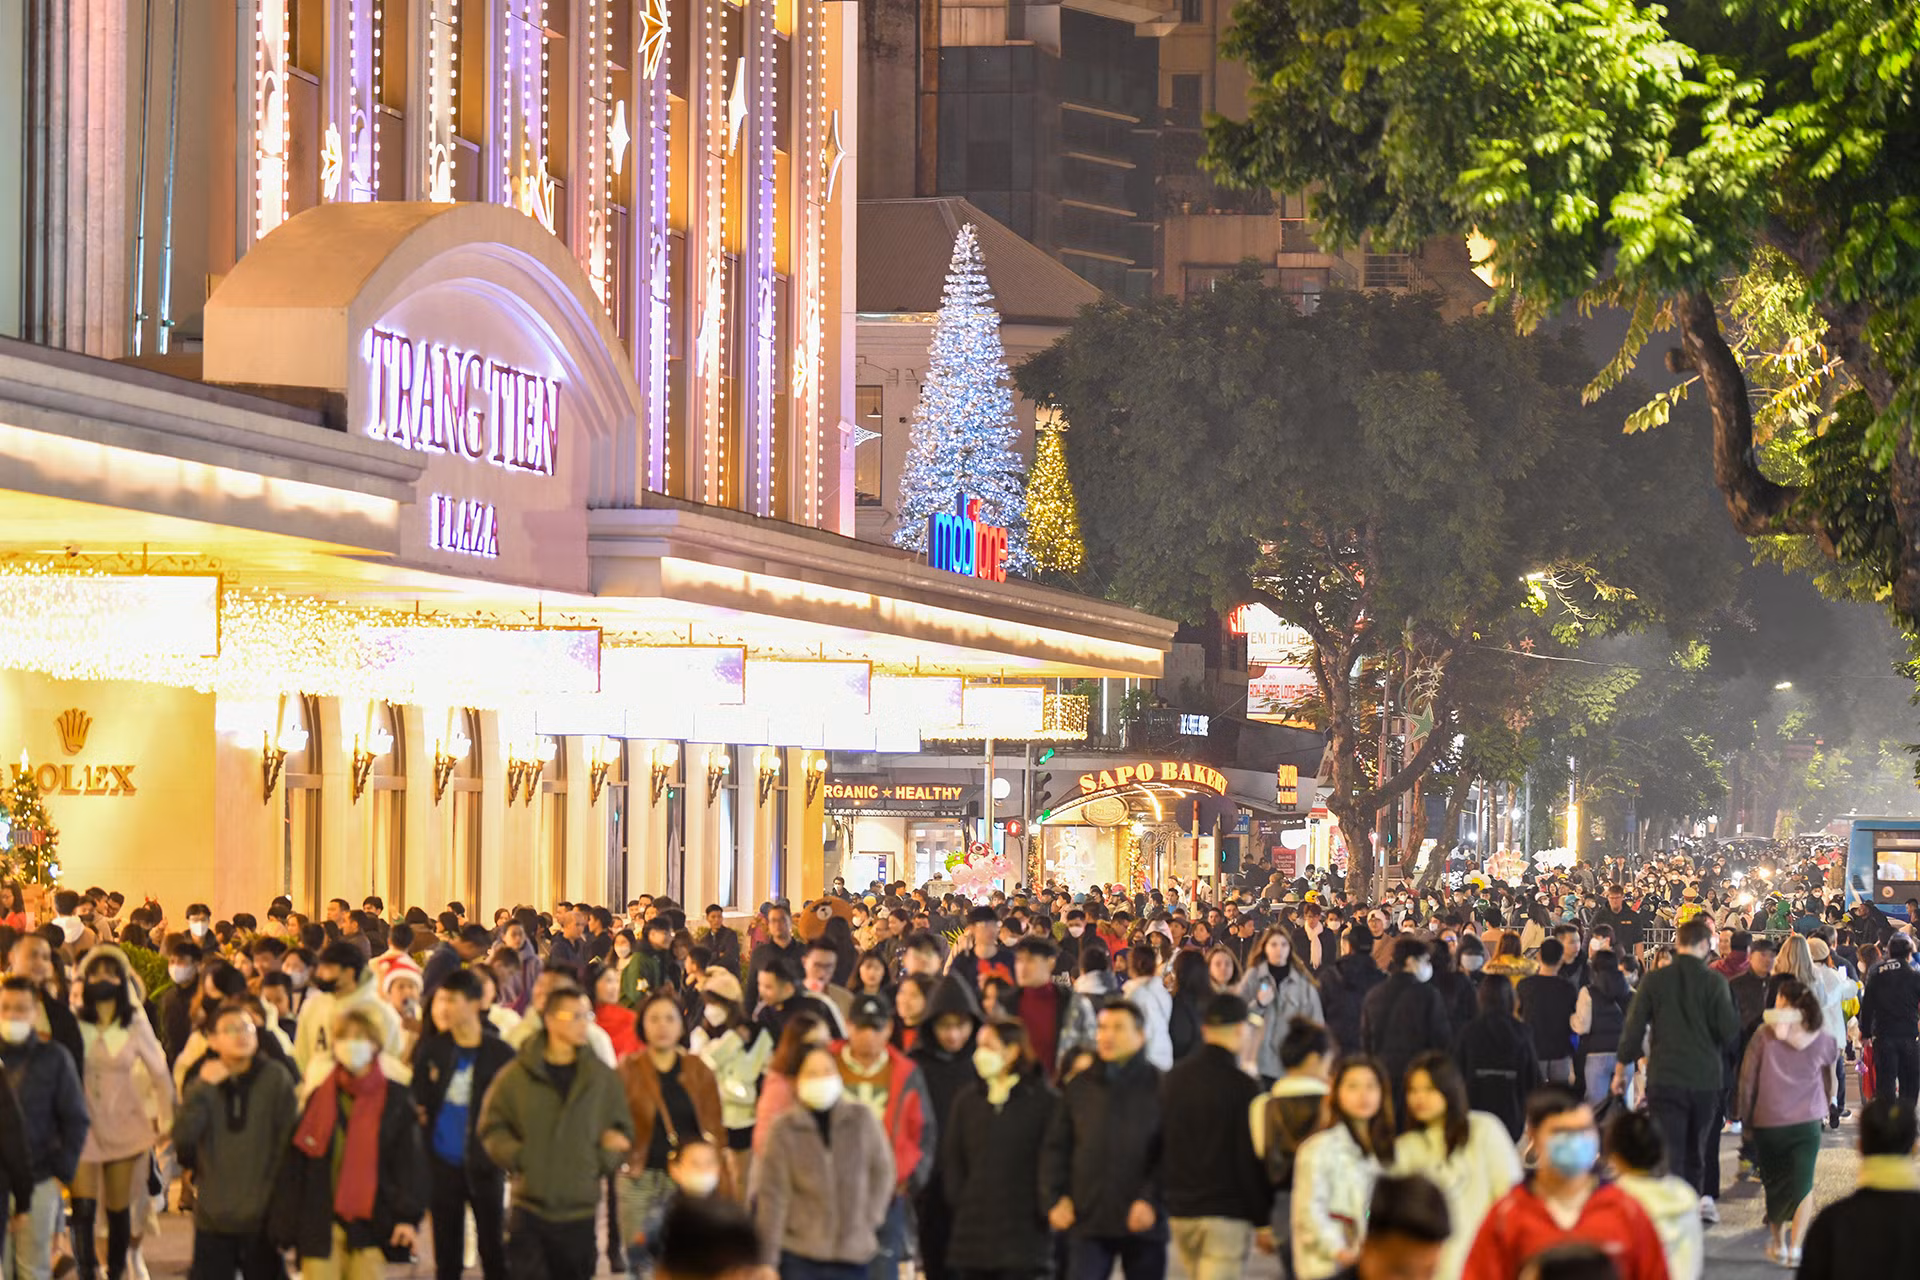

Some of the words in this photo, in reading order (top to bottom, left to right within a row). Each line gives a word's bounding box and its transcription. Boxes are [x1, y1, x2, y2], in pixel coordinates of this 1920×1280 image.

[363, 324, 485, 462] TRANG
[484, 357, 562, 477] TIEN
[430, 493, 500, 559] PLAZA
[824, 784, 879, 799] RGANIC
[895, 785, 962, 800] HEALTHY
[1079, 762, 1155, 795] SAPO
[1160, 761, 1229, 796] BAKERY
